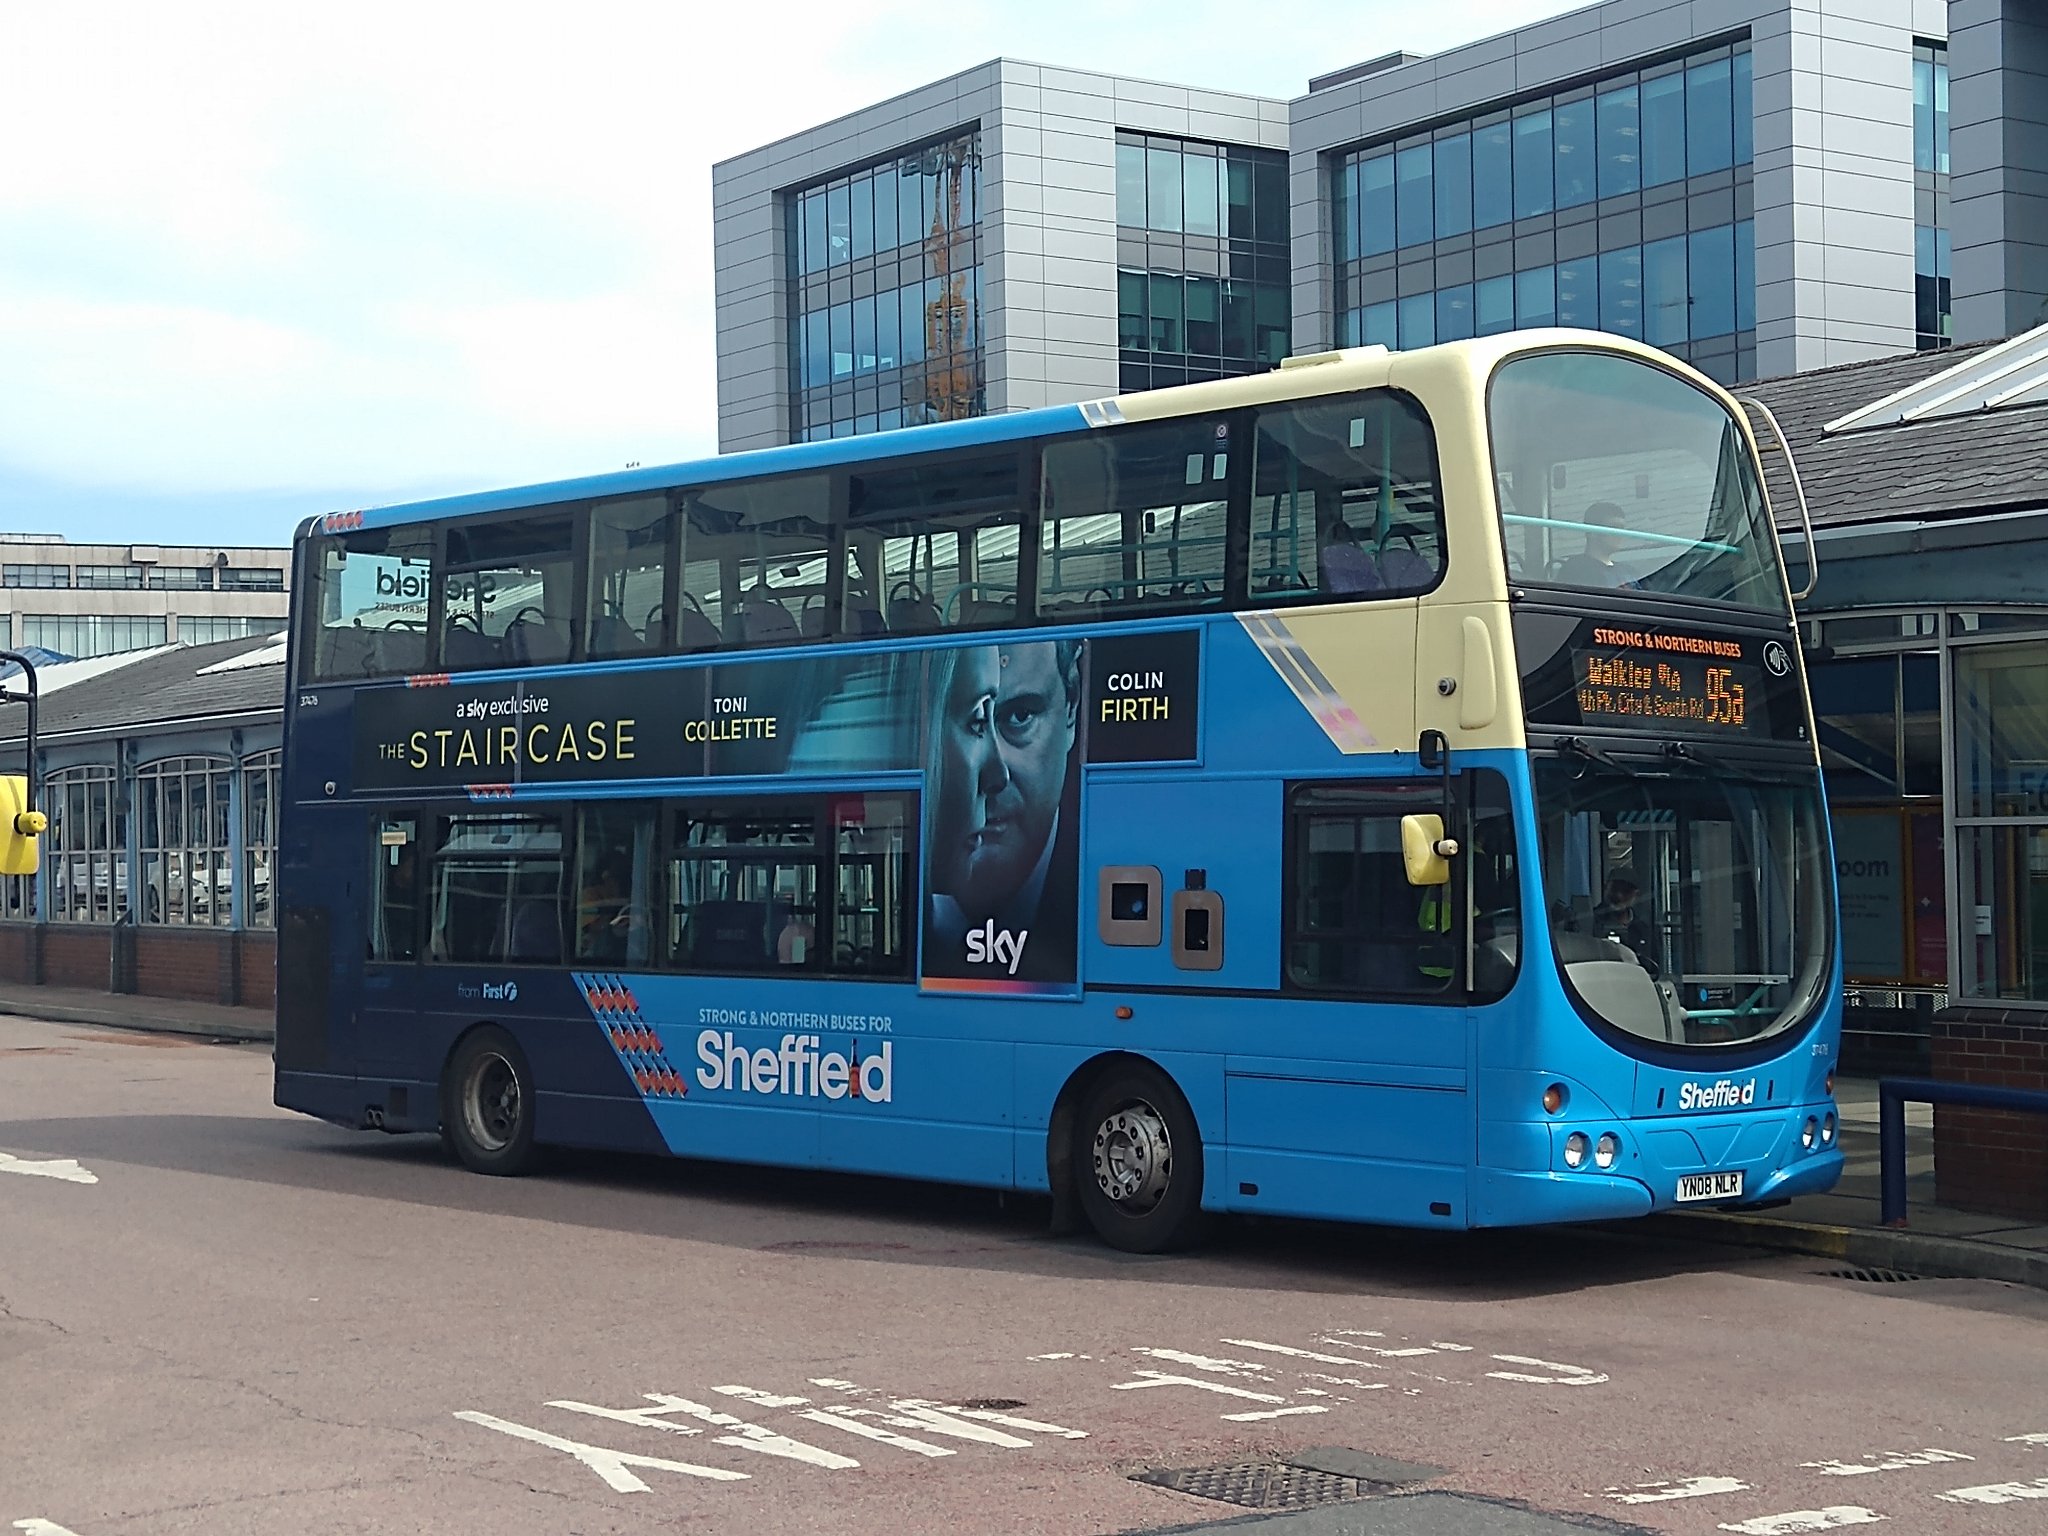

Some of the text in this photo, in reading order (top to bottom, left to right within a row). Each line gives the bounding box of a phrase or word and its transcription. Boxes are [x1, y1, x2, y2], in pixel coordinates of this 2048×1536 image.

[1594, 628, 1742, 658] STRONG & NORTHERN BUSES
[1108, 671, 1164, 692] COLIN
[456, 695, 549, 721] a sky exclusive
[713, 697, 747, 714] TONI
[1706, 667, 1745, 725] 95a
[1101, 696, 1170, 723] FIRTH
[684, 717, 777, 743] COLLETTE
[379, 719, 636, 770] THE STAIRCASE
[1838, 859, 1889, 878] oom
[965, 918, 1028, 976] sky
[457, 982, 505, 999] from First
[699, 1007, 892, 1033] STRONG & NORTHERN BUSES FOR
[696, 1029, 893, 1104] Sheffield
[1678, 1078, 1756, 1110] Sheffield
[1682, 1174, 1739, 1198] YN08 NLR
